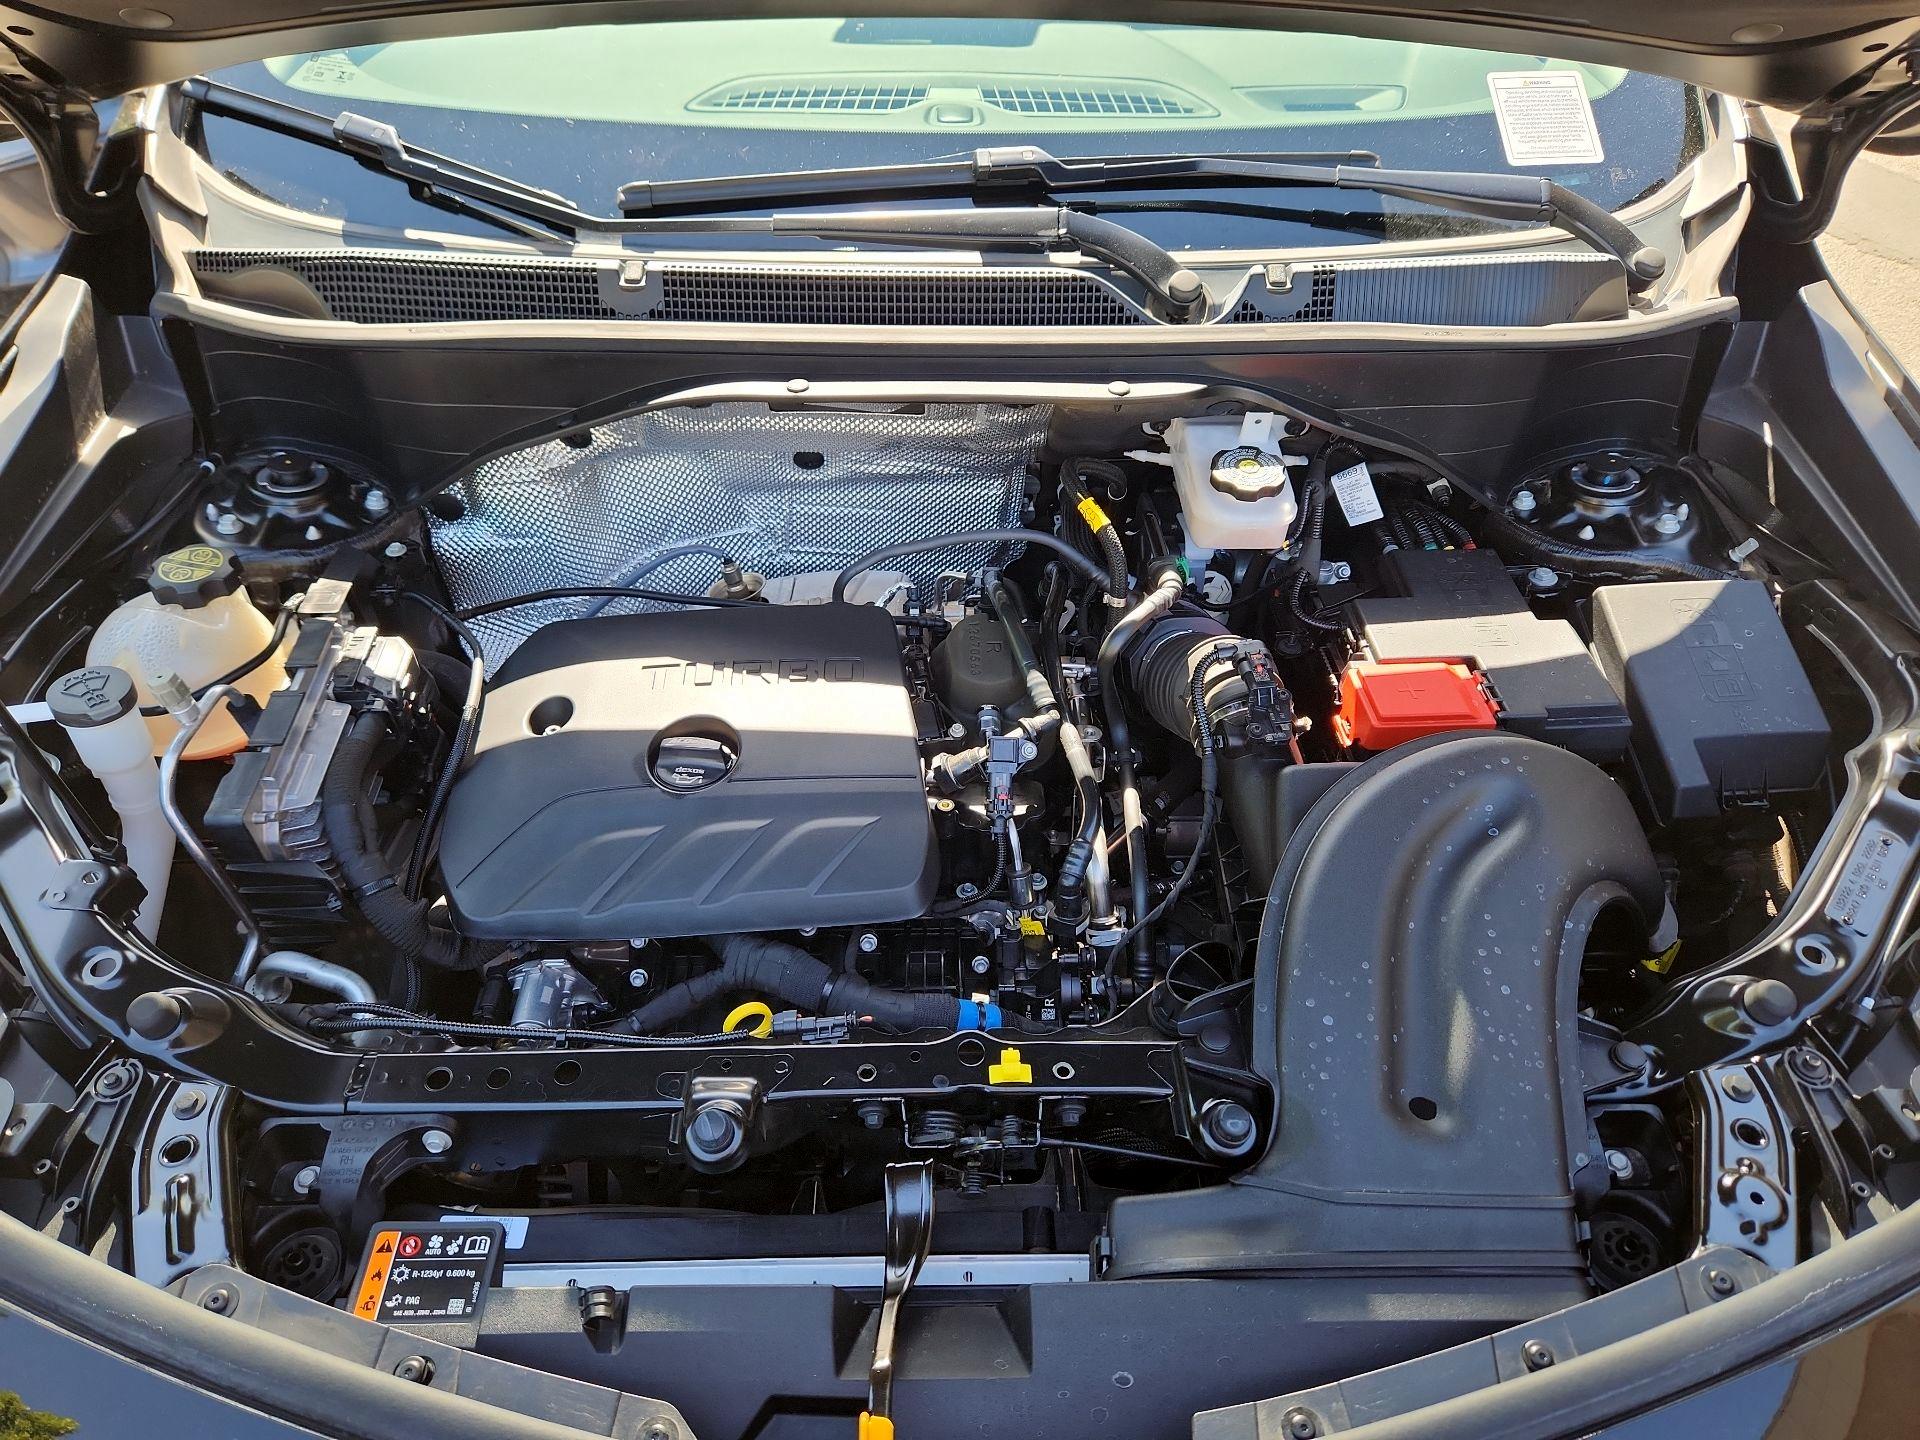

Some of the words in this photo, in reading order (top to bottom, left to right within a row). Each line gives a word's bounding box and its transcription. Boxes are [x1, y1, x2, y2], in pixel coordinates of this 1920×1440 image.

[642, 656, 864, 690] TURBO
[675, 766, 705, 774] dexos
[1044, 998, 1055, 1006] R
[339, 1154, 354, 1166] RH
[425, 1248, 442, 1256] AUTO
[412, 1269, 444, 1279] R-1234yf
[446, 1269, 466, 1277] 0.600
[466, 1269, 476, 1278] kg
[405, 1296, 421, 1305] PAG
